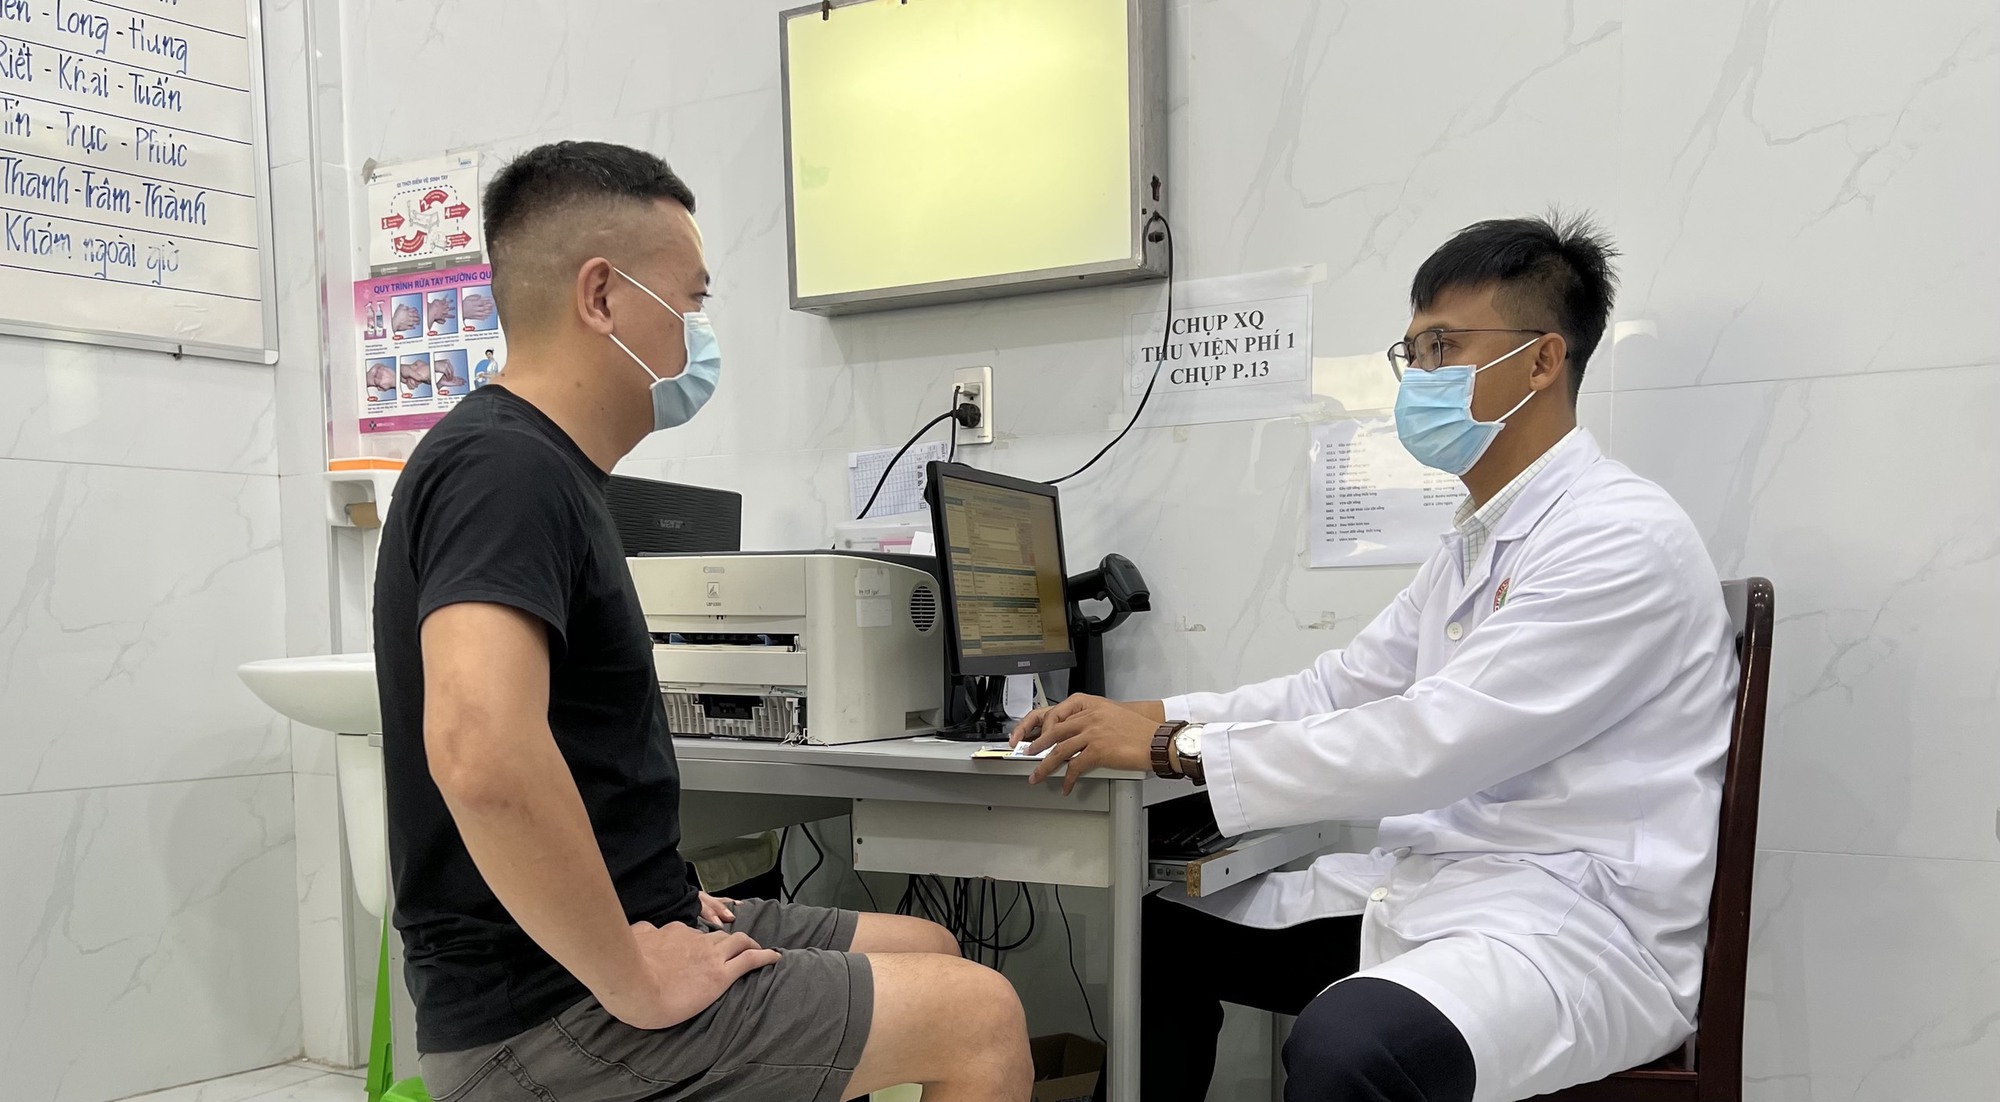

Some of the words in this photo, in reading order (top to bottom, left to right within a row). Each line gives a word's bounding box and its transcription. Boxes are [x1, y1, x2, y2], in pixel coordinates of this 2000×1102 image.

[56, 0, 109, 55] Long
[128, 73, 182, 112] Tuấn
[374, 284, 390, 294] QUY
[391, 281, 413, 292] TRÌNH
[432, 277, 444, 286] TAY
[445, 272, 478, 284] THƯỜNG
[480, 271, 492, 280] QU
[1172, 314, 1228, 336] CHỤP
[1234, 310, 1265, 330] XQ
[1141, 343, 1183, 363] THU
[1189, 337, 1238, 360] VIỆN
[1244, 329, 1280, 353] PHÍ
[1287, 332, 1295, 348] 1
[1170, 364, 1227, 386] CHỤP
[1232, 360, 1270, 380] P.13
